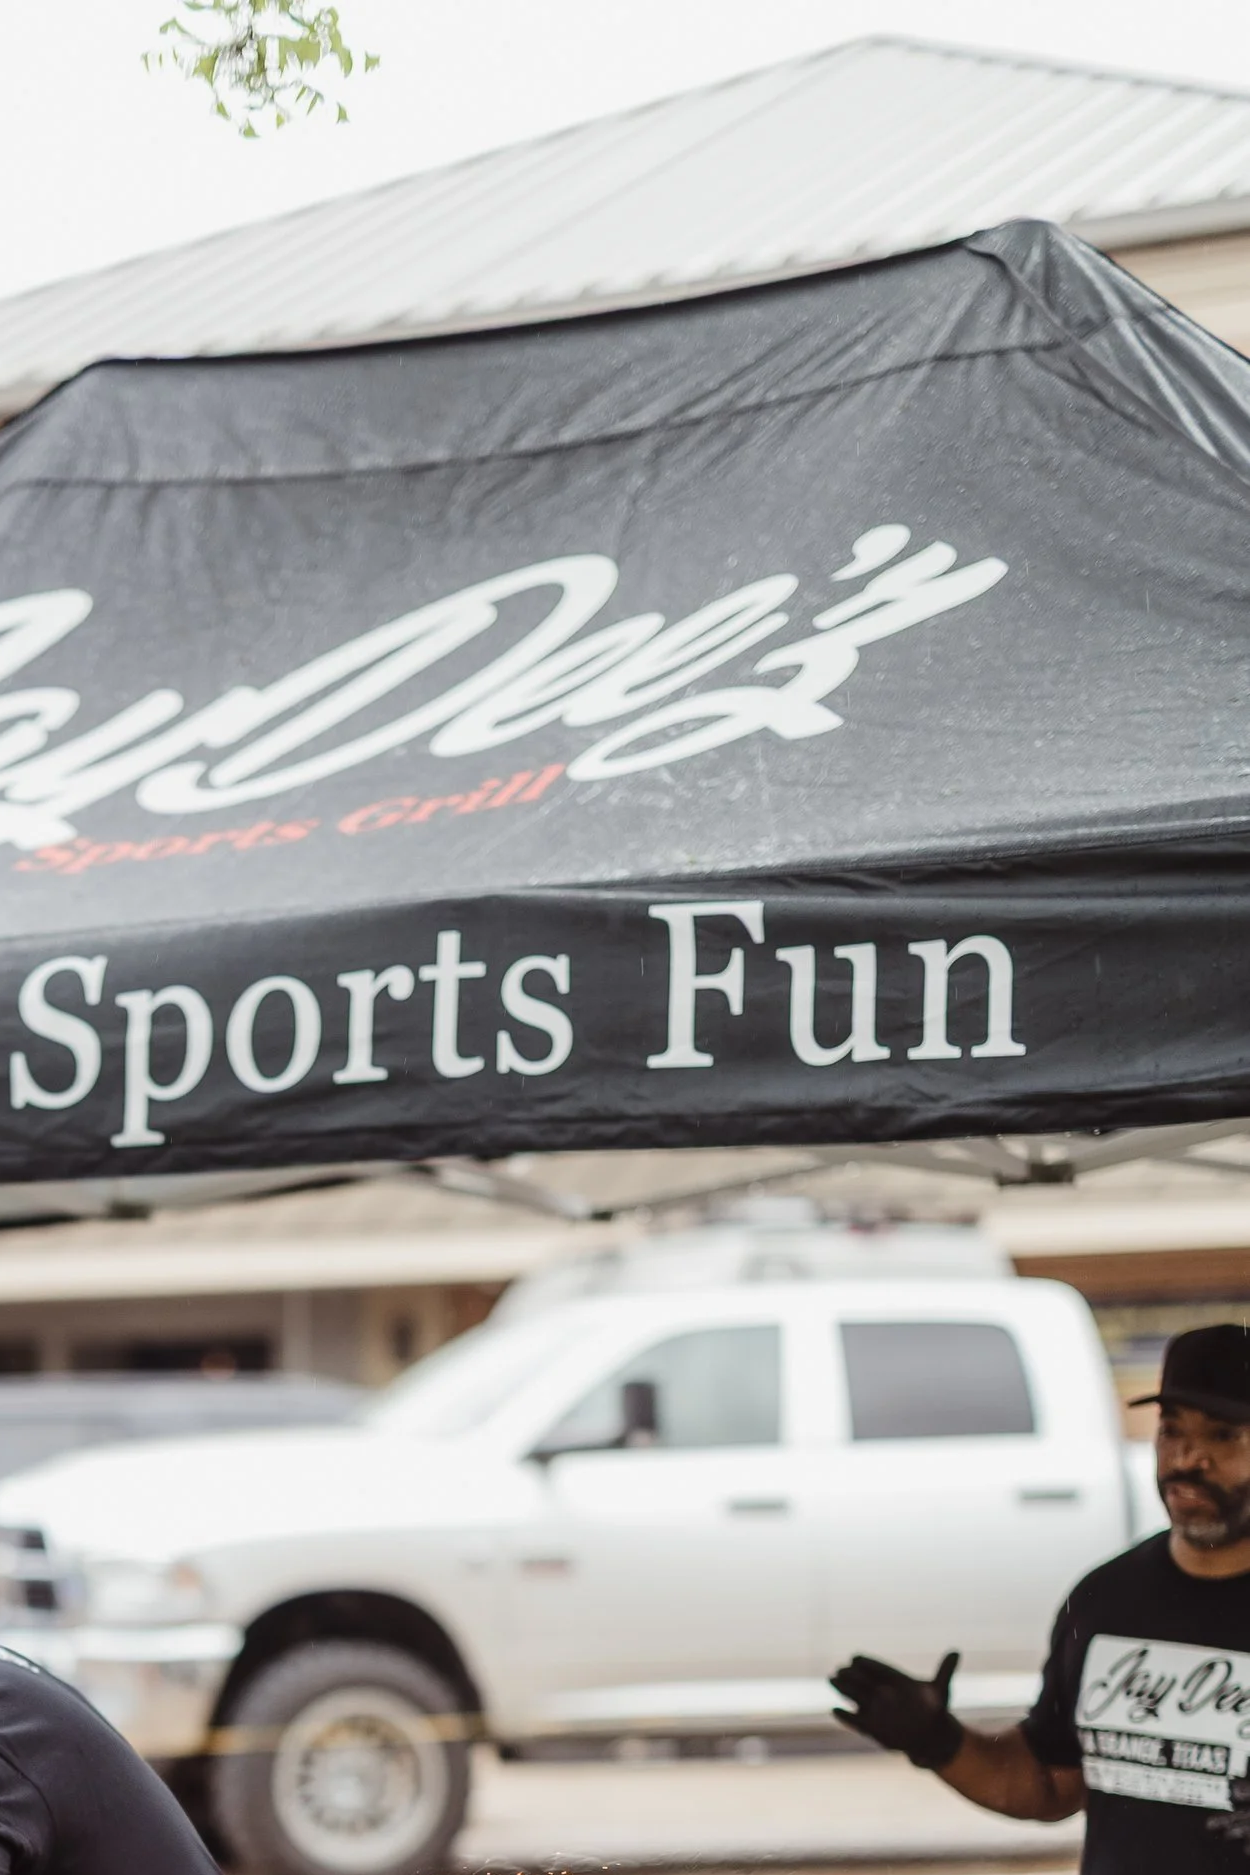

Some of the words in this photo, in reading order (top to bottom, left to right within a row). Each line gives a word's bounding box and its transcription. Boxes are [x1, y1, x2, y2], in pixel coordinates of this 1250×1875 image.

[12, 819, 321, 875] Sports
[337, 762, 567, 836] Grill
[9, 928, 574, 1148] Sports
[645, 900, 1028, 1069] Fun
